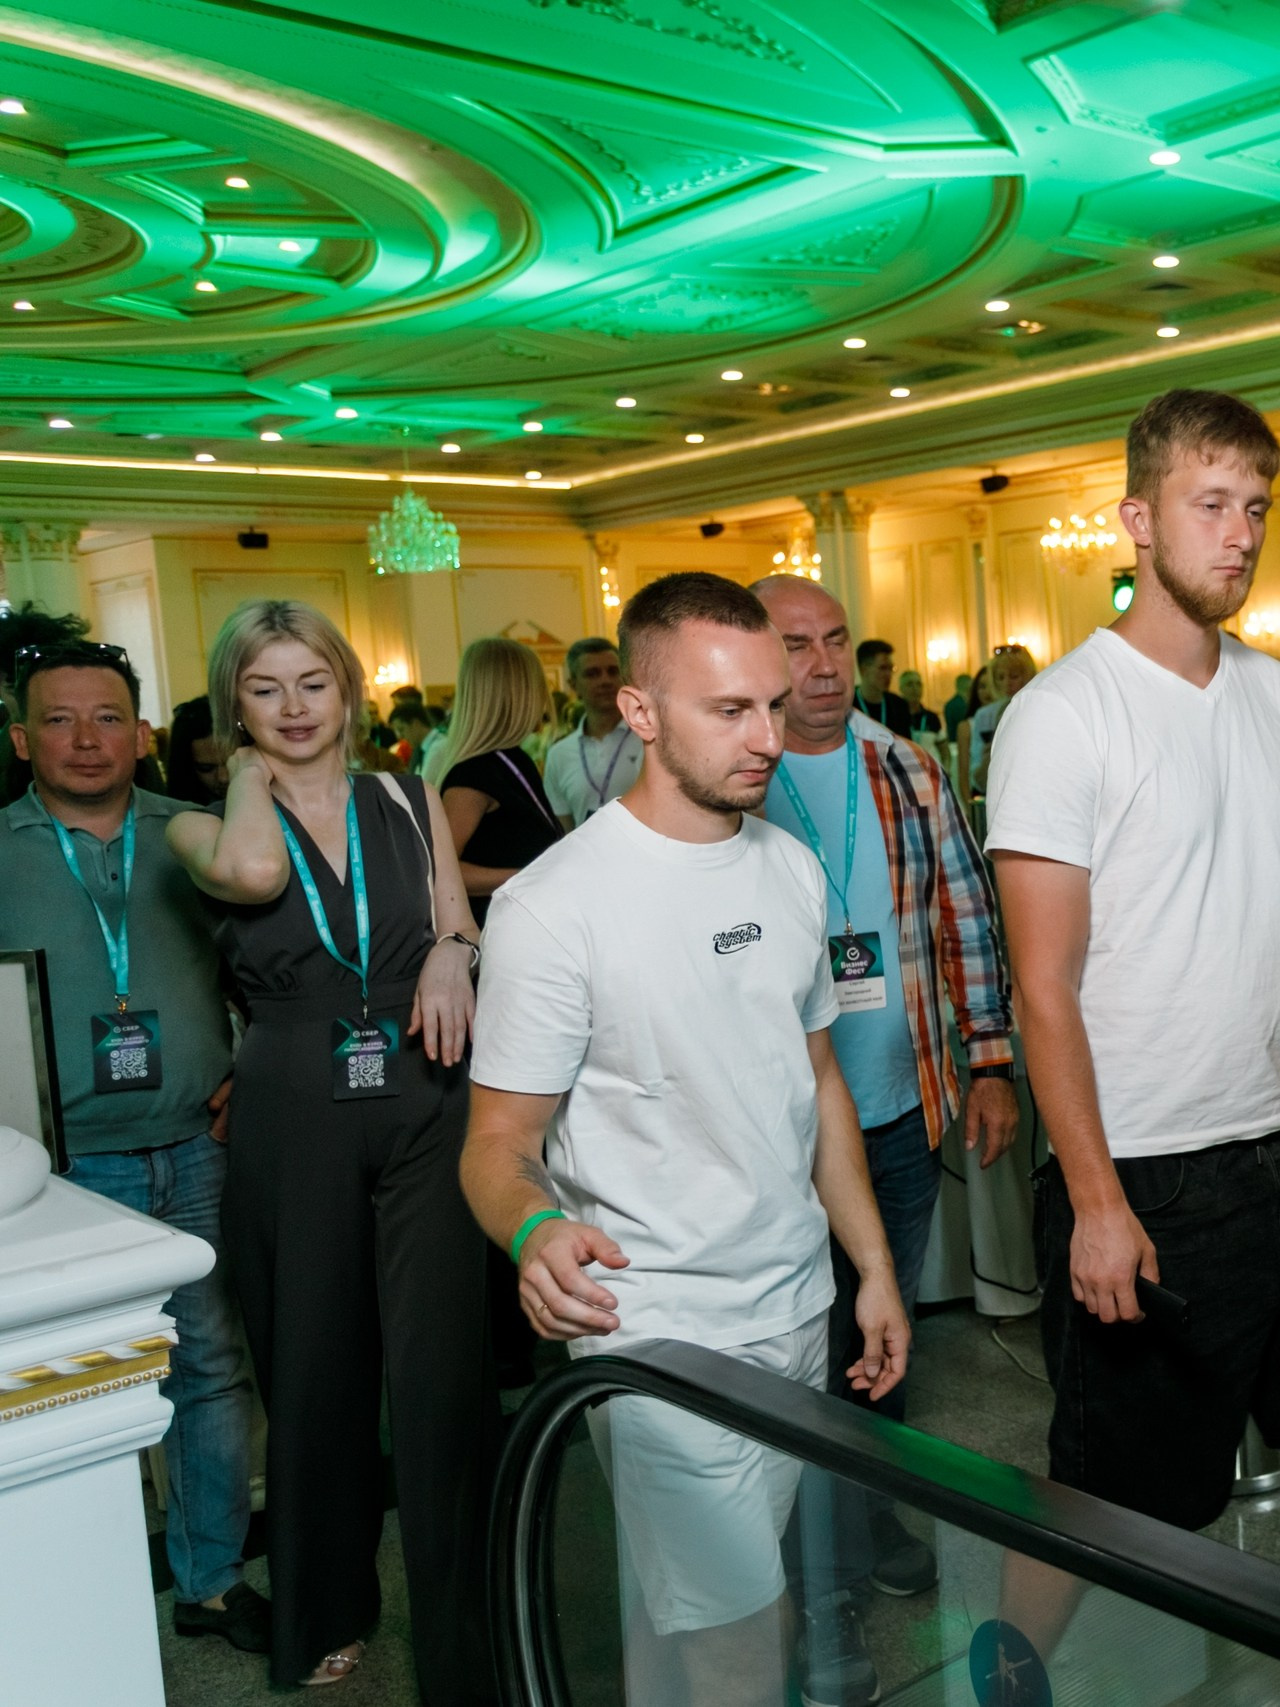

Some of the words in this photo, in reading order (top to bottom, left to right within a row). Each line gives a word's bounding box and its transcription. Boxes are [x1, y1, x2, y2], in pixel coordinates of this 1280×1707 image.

[719, 934, 762, 949] system
[840, 960, 868, 969] Бизнес
[845, 968, 865, 976] Фест
